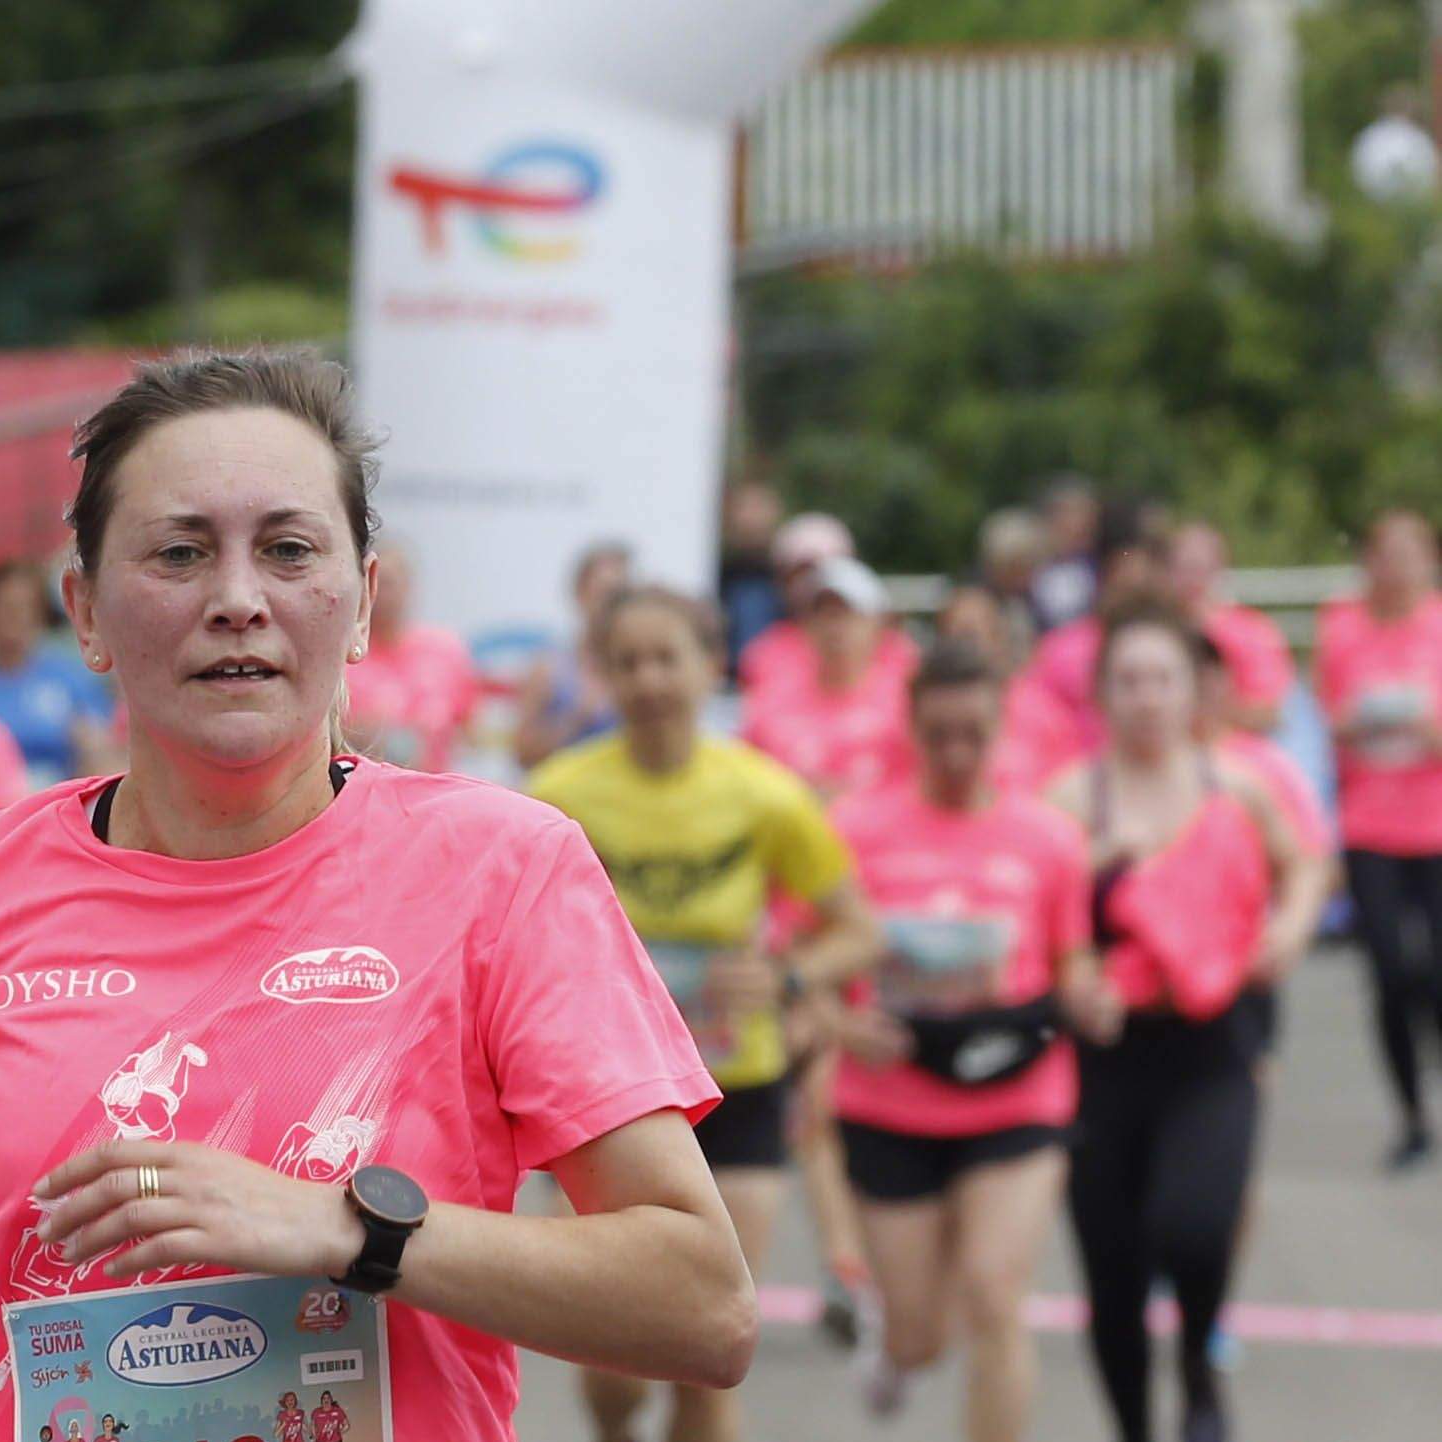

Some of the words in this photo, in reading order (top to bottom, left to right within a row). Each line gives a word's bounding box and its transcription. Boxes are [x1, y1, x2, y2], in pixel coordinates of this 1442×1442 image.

[271, 969, 388, 993] ASTURIANA
[29, 1324, 43, 1337] TU
[44, 1319, 85, 1335] DORSAL
[139, 1331, 189, 1344] CENTRAL
[192, 1324, 250, 1338] LECHERA
[31, 1333, 86, 1357] SUMA
[118, 1336, 258, 1371] ASTURIANA
